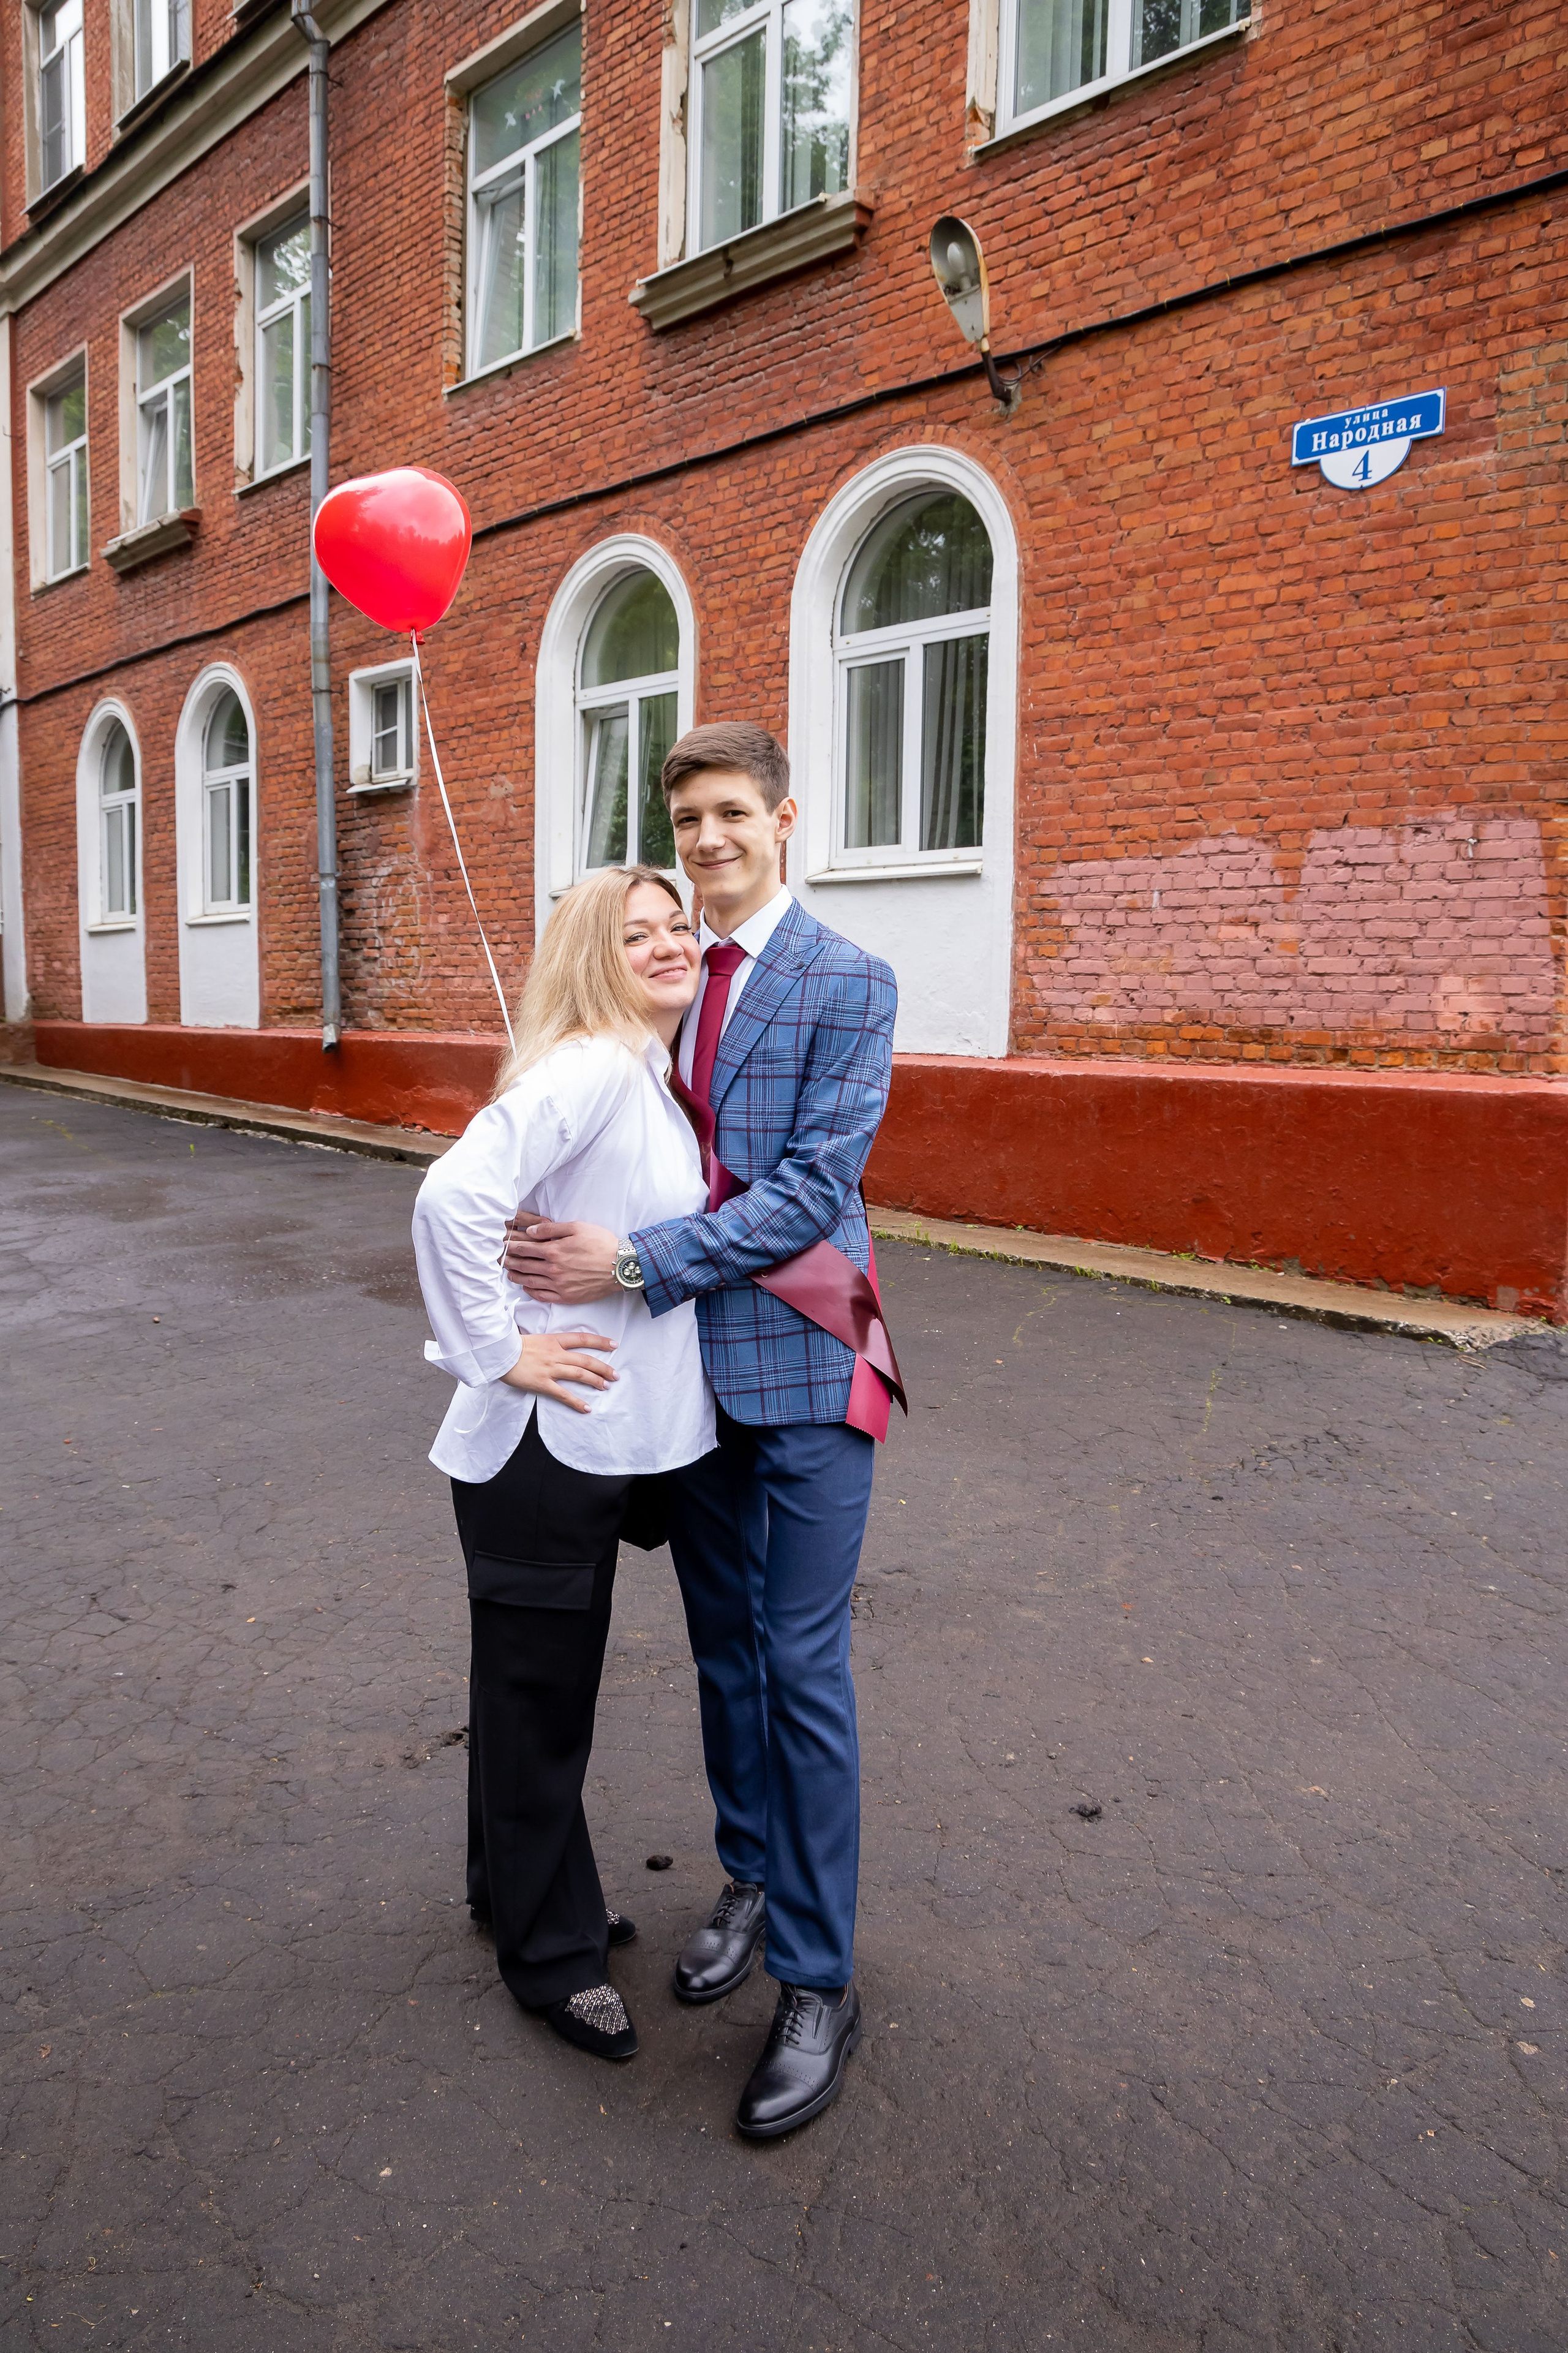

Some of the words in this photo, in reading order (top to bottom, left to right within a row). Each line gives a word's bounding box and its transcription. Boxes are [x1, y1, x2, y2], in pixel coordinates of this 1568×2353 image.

[1311, 414, 1422, 452] Народная
[1344, 407, 1389, 428] улица
[1352, 450, 1372, 482] 4
